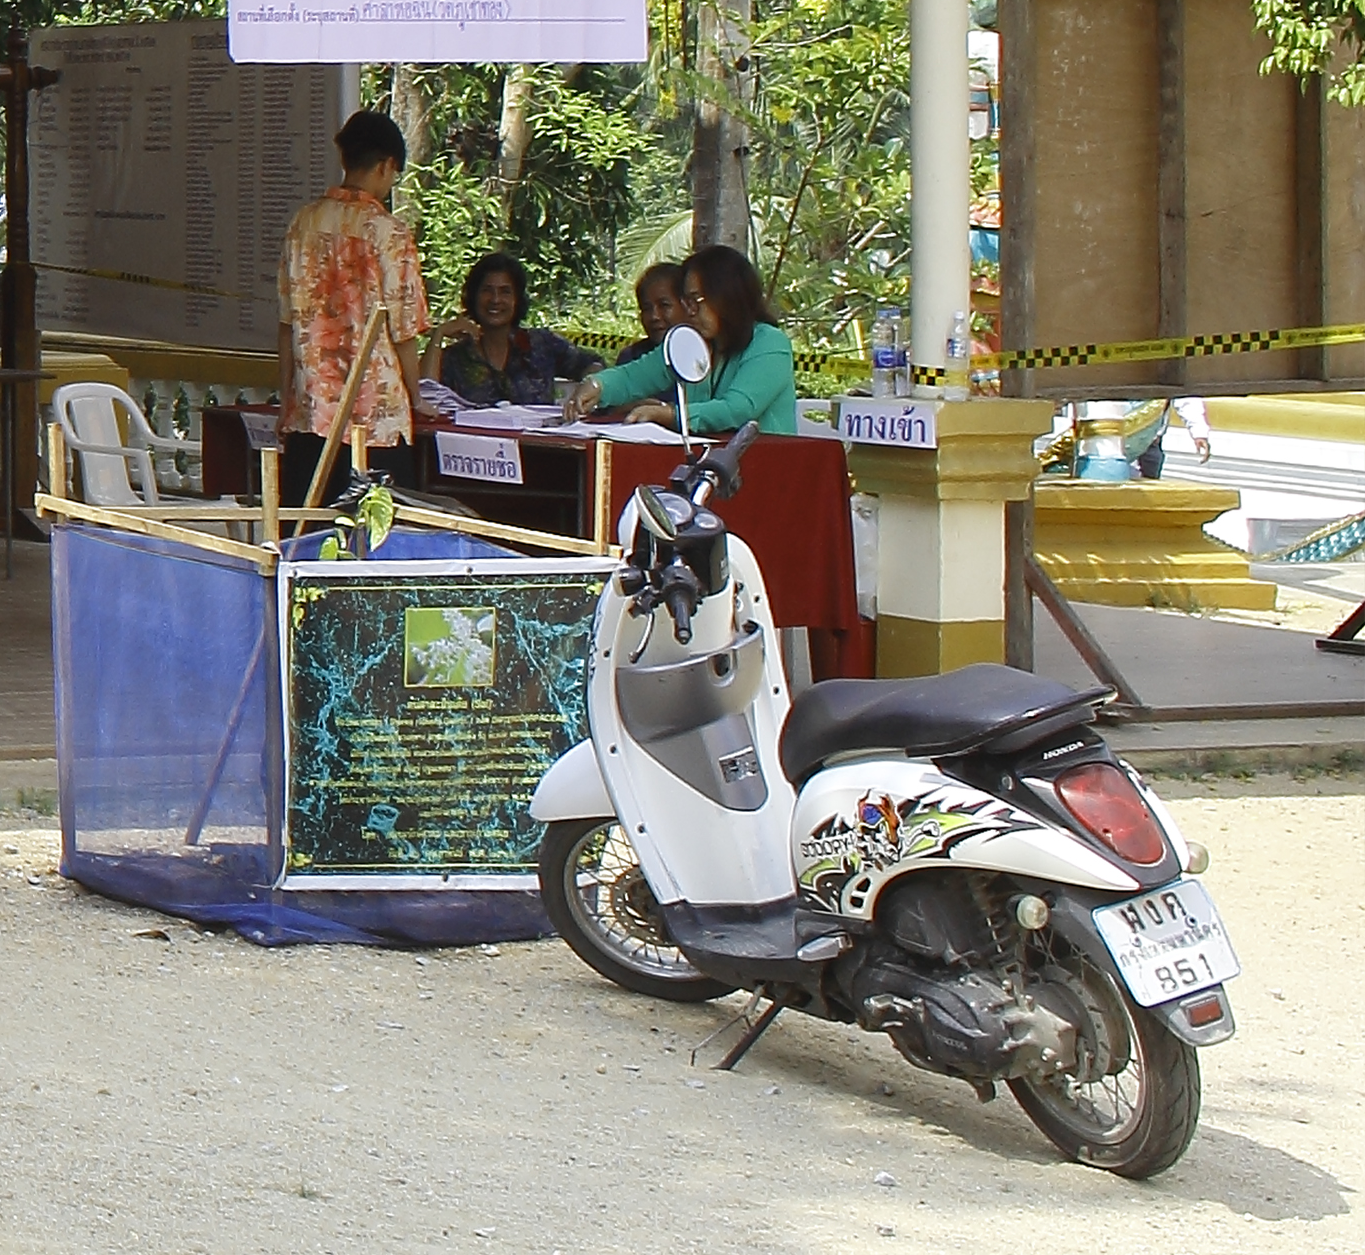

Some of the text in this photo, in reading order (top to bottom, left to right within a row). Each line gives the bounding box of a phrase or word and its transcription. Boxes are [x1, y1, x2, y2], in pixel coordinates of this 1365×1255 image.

[845, 405, 926, 443] ทางเข้า
[442, 442, 517, 478] ตรวจรายชื่อ
